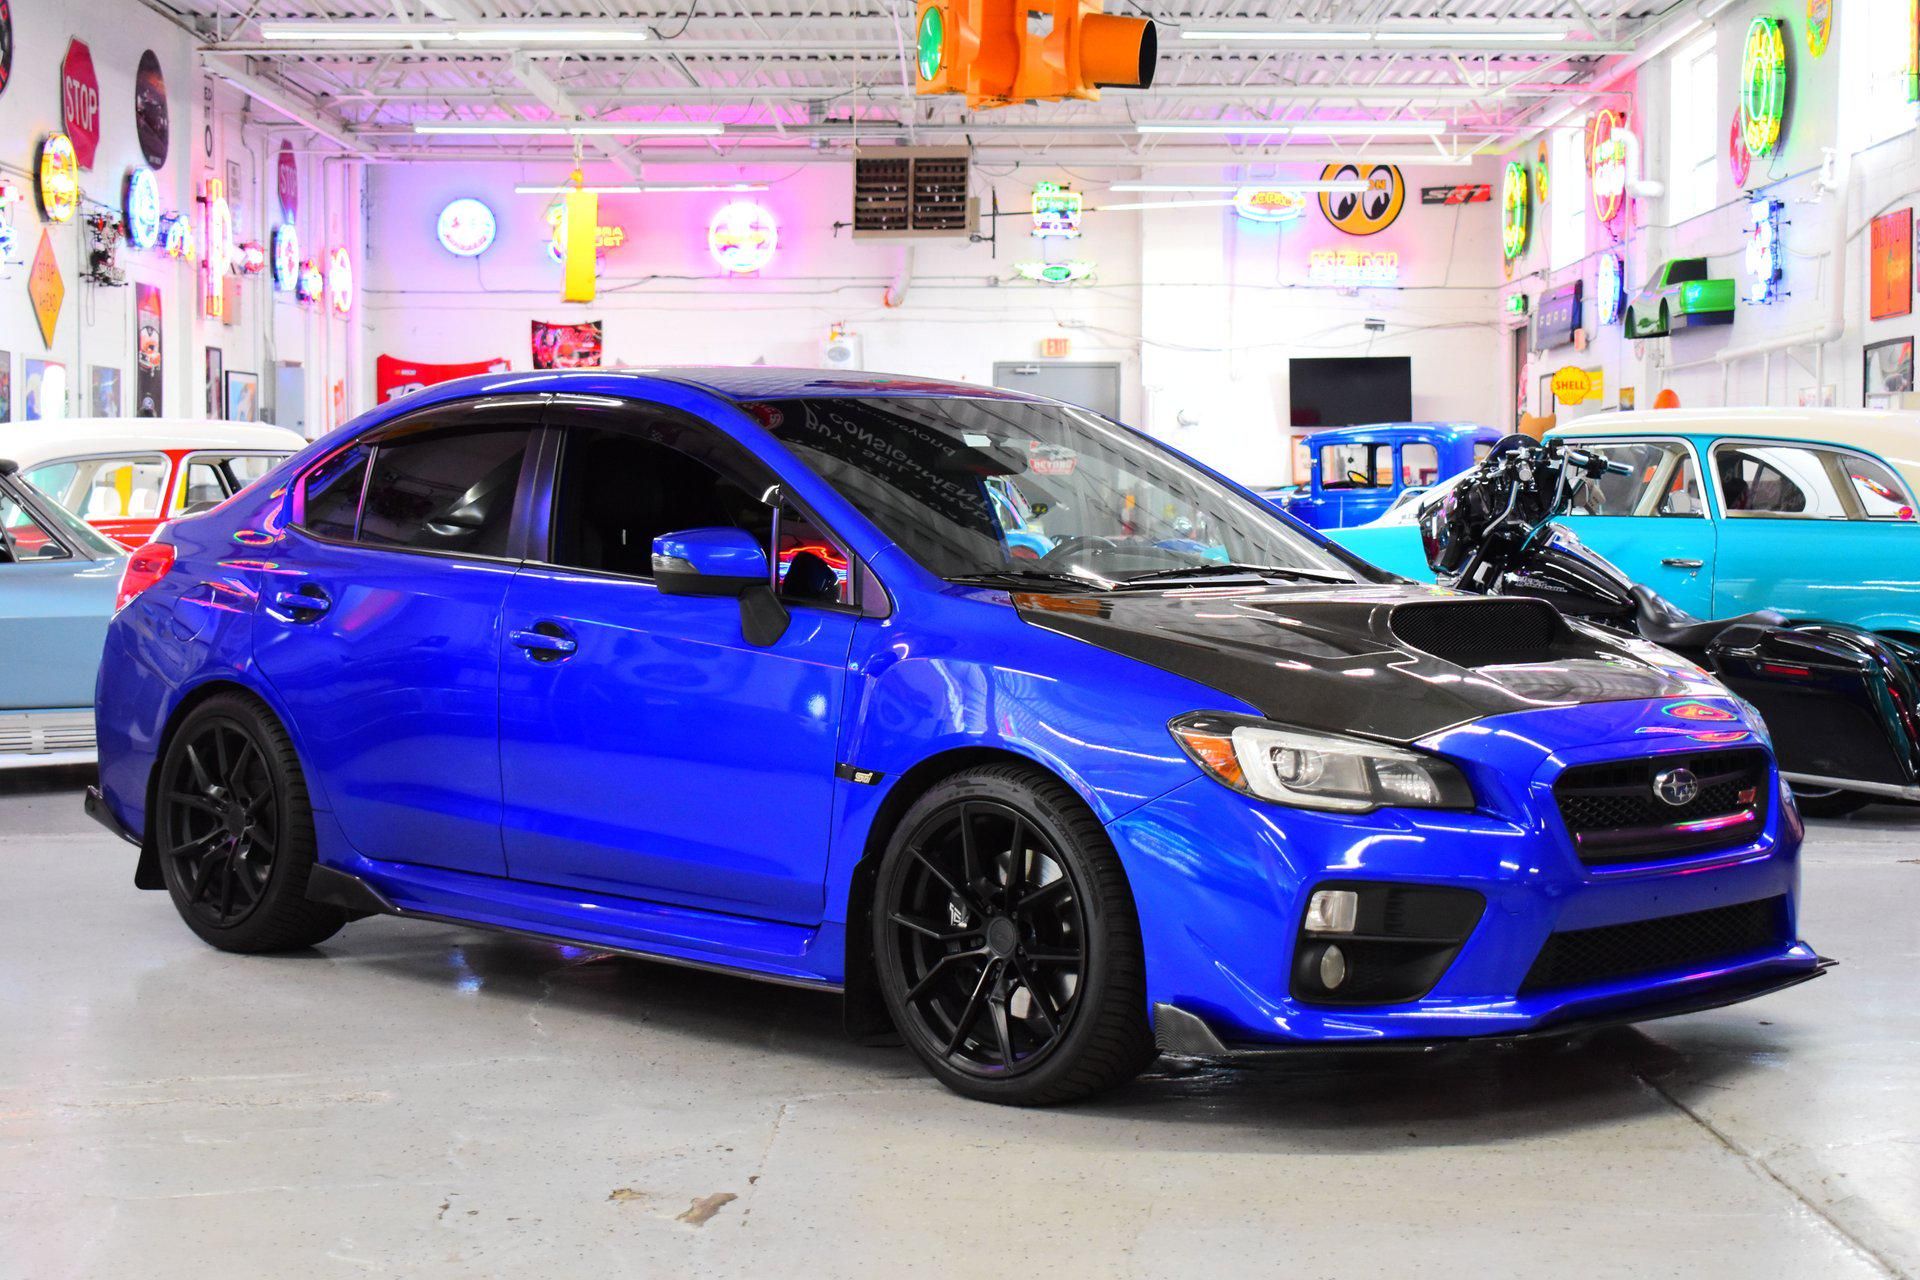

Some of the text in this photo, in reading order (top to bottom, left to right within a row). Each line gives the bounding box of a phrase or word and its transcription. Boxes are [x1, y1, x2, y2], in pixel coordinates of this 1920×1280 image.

[66, 75, 98, 133] STOP
[1423, 186, 1489, 202] SRT
[1047, 338, 1069, 353] EXIT
[1556, 380, 1587, 390] SHELL
